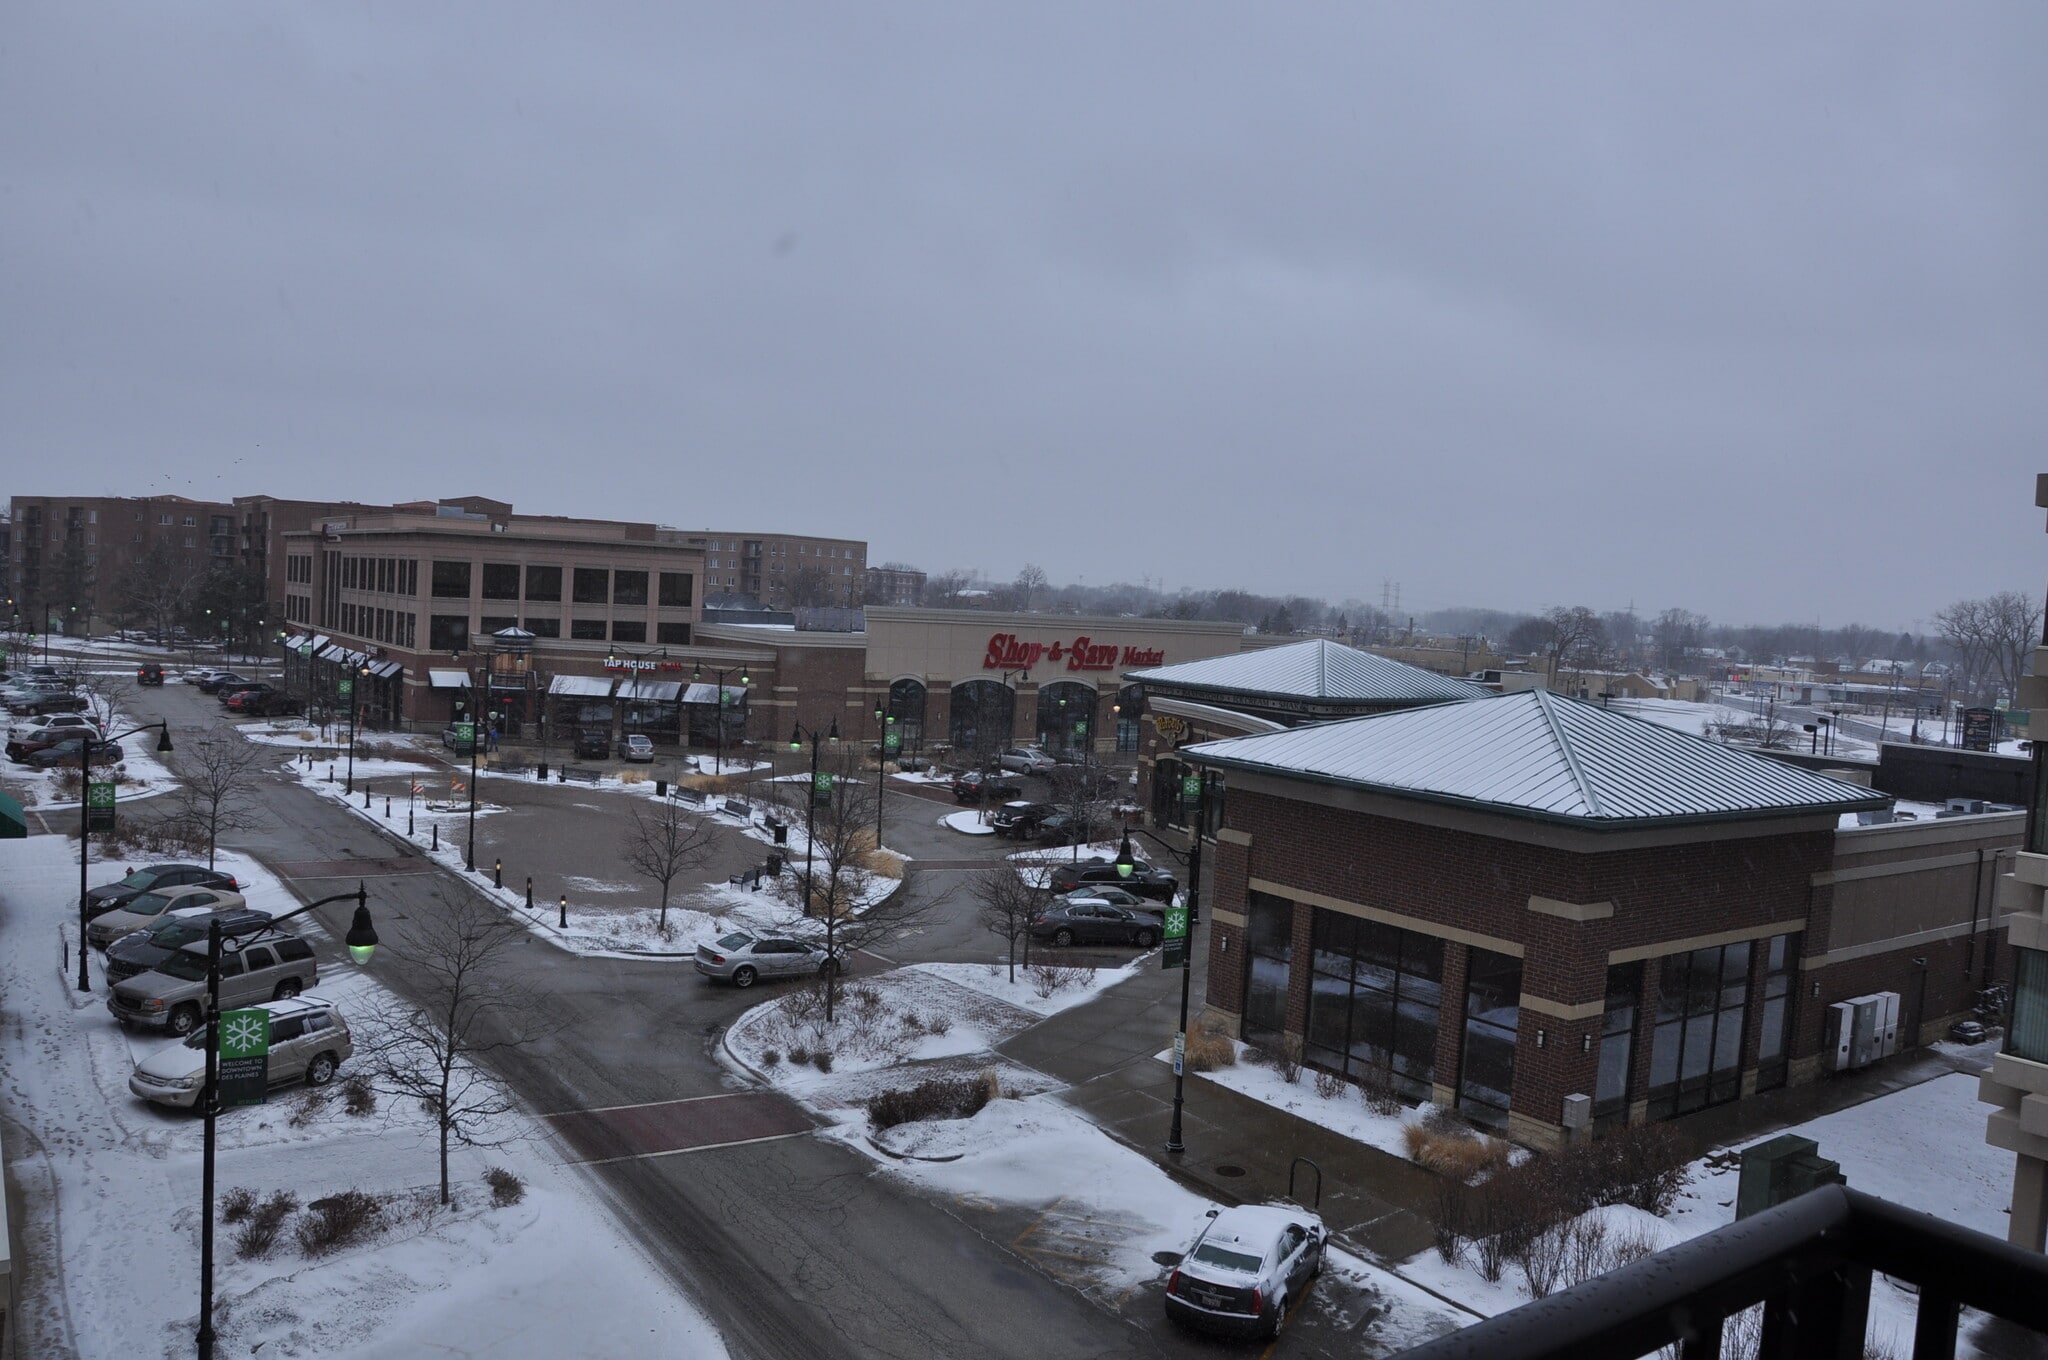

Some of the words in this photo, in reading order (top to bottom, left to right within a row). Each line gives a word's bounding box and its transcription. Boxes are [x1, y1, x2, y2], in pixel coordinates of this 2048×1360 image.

[1120, 646, 1166, 667] Market
[603, 658, 622, 668] TAP
[623, 660, 656, 670] HOUSE
[222, 1059, 252, 1067] WELCOME
[222, 1065, 262, 1074] DOWNTOWN
